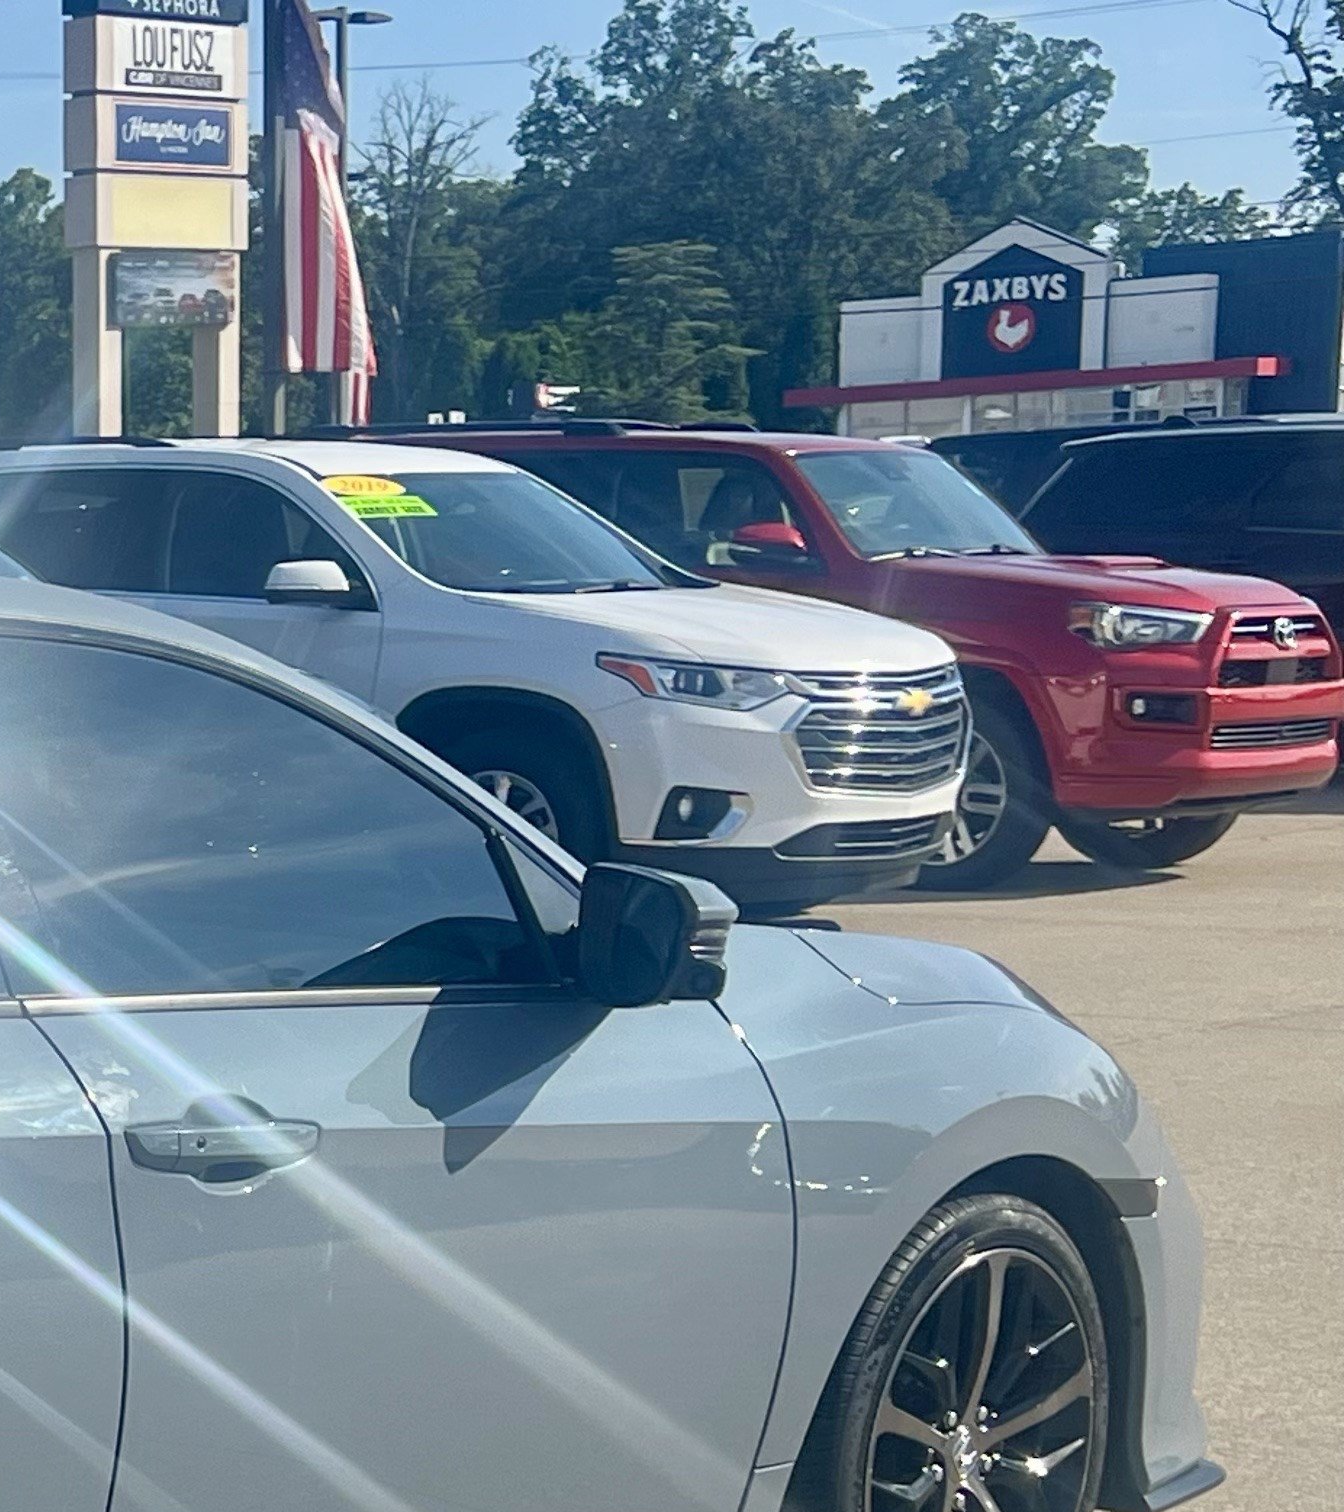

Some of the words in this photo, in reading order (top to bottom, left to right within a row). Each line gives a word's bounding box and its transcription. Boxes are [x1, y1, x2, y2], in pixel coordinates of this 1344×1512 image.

[132, 24, 166, 68] LOU
[170, 28, 215, 72] FUSZ
[121, 115, 190, 143] Hampton
[192, 118, 226, 146] Inn
[952, 273, 1067, 307] ZAXBYS
[338, 480, 389, 492] 2019
